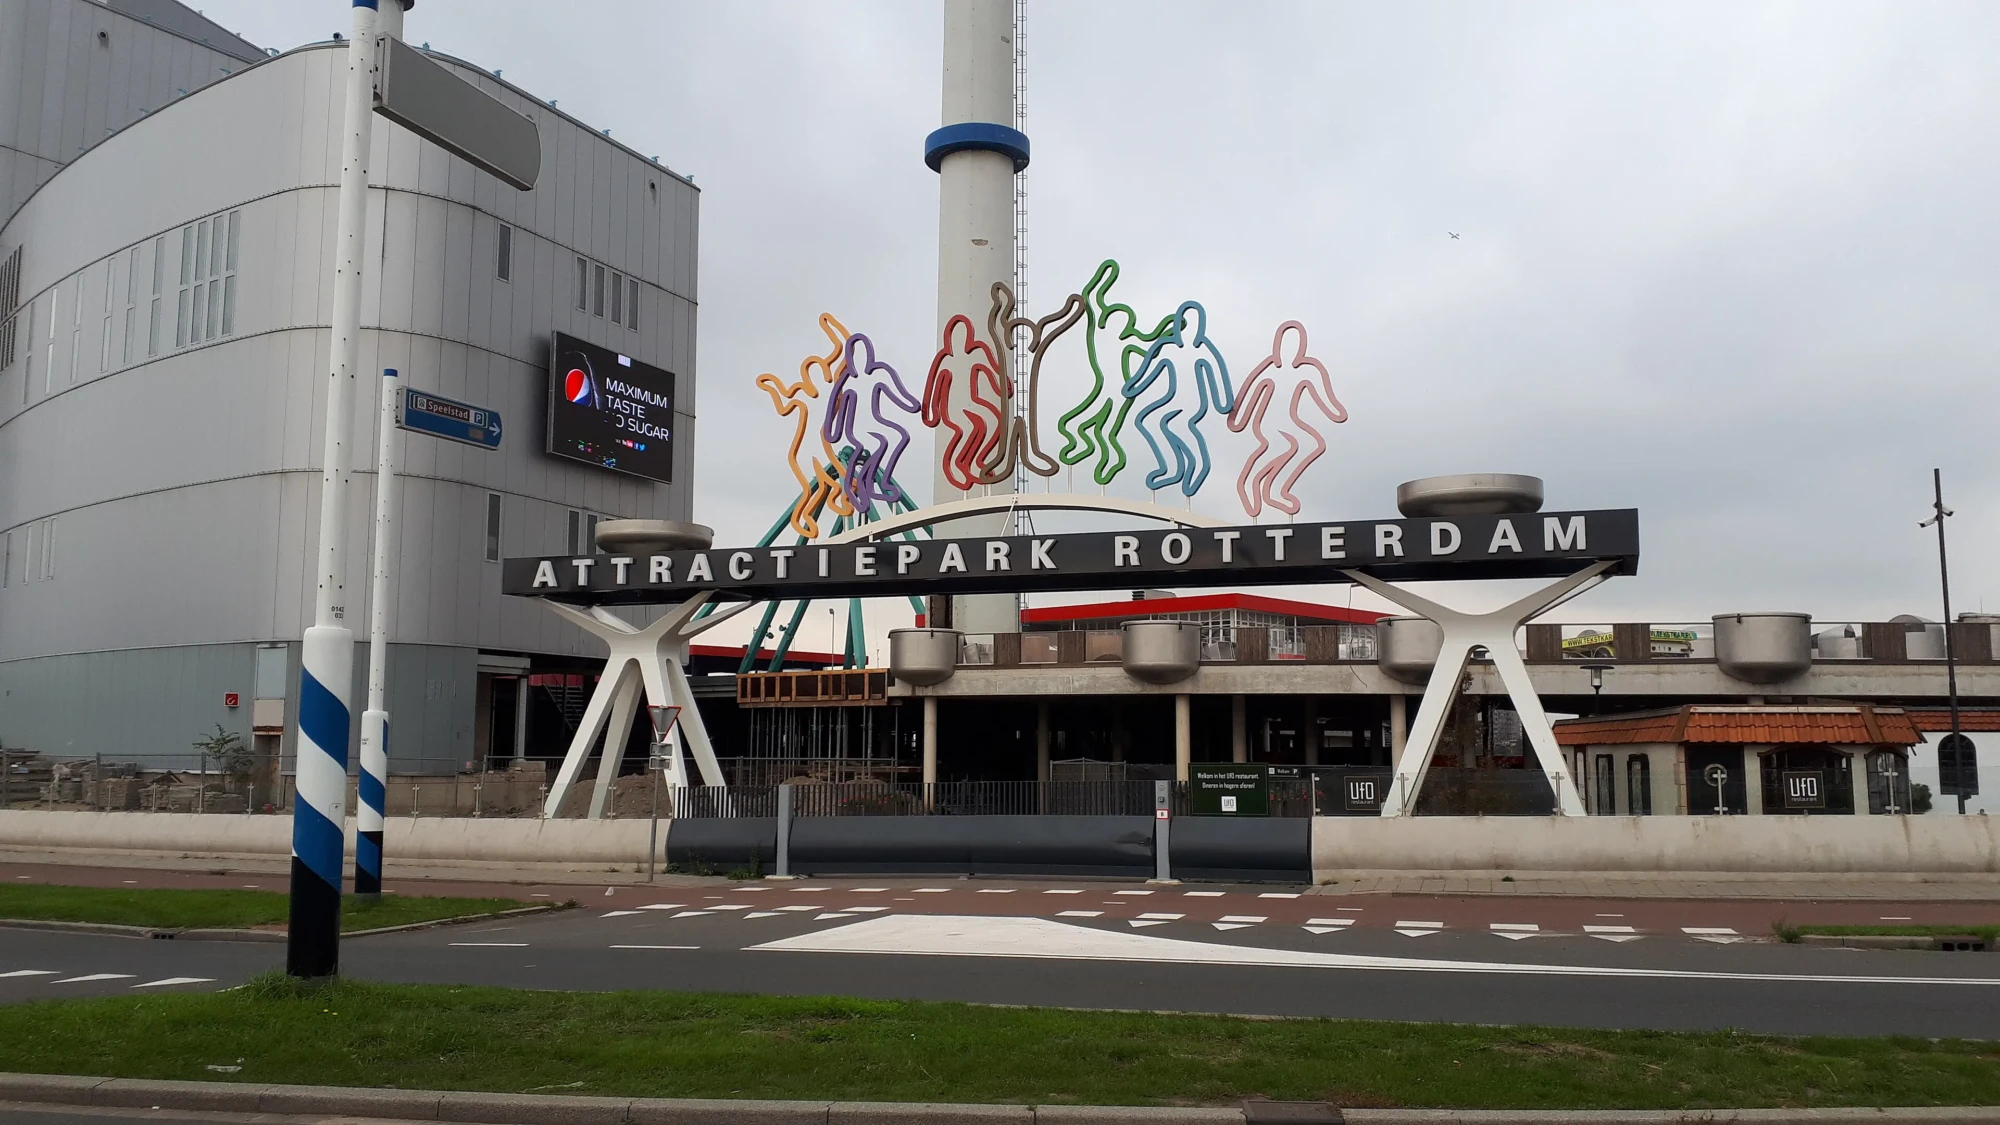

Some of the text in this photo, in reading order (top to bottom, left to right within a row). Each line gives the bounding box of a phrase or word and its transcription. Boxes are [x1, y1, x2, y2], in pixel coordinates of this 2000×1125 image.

[606, 377, 667, 409] MAXIMUM
[428, 401, 468, 419] Speelstad
[606, 394, 645, 419] TASTE
[628, 418, 669, 441] SUGAR
[532, 515, 1587, 588] ATTRACTIEPARK ROTTERDAM
